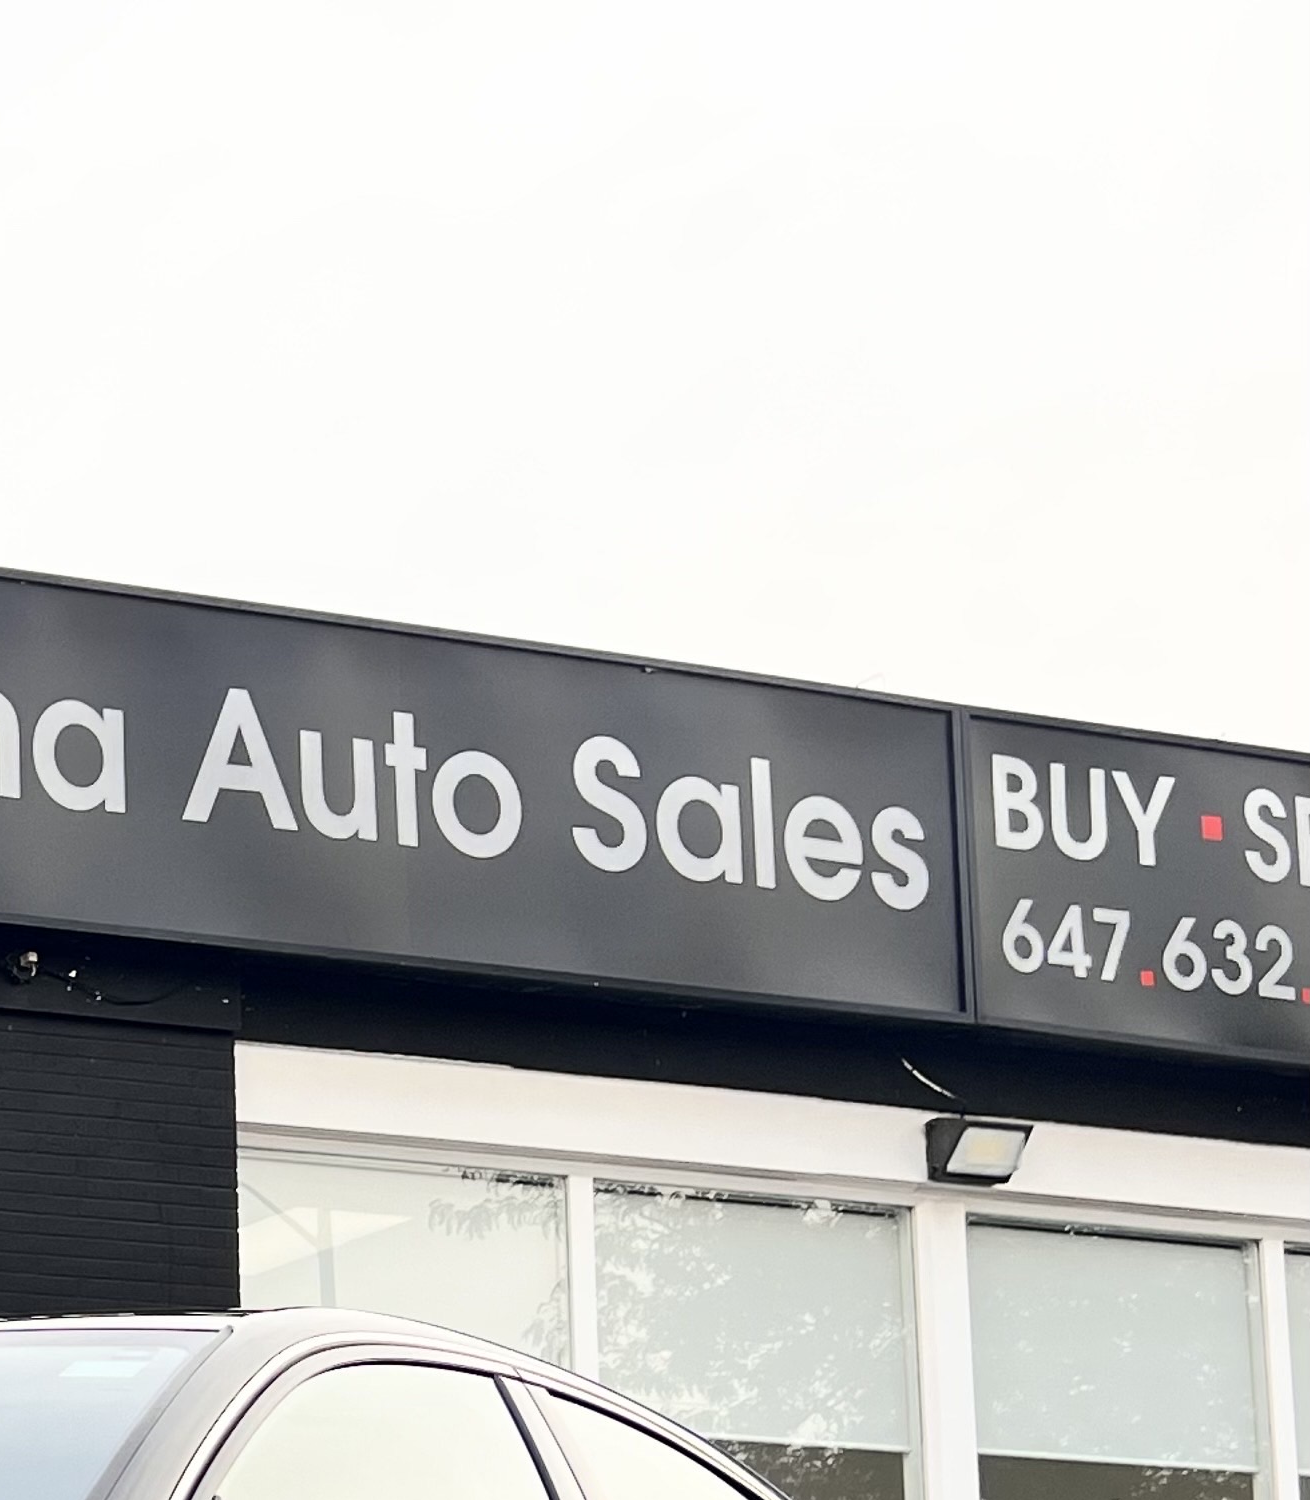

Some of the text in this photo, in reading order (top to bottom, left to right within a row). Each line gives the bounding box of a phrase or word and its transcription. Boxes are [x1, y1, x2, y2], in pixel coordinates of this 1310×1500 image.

[182, 687, 523, 858] Auto
[572, 735, 930, 911] Sales
[991, 753, 1176, 867] BUY
